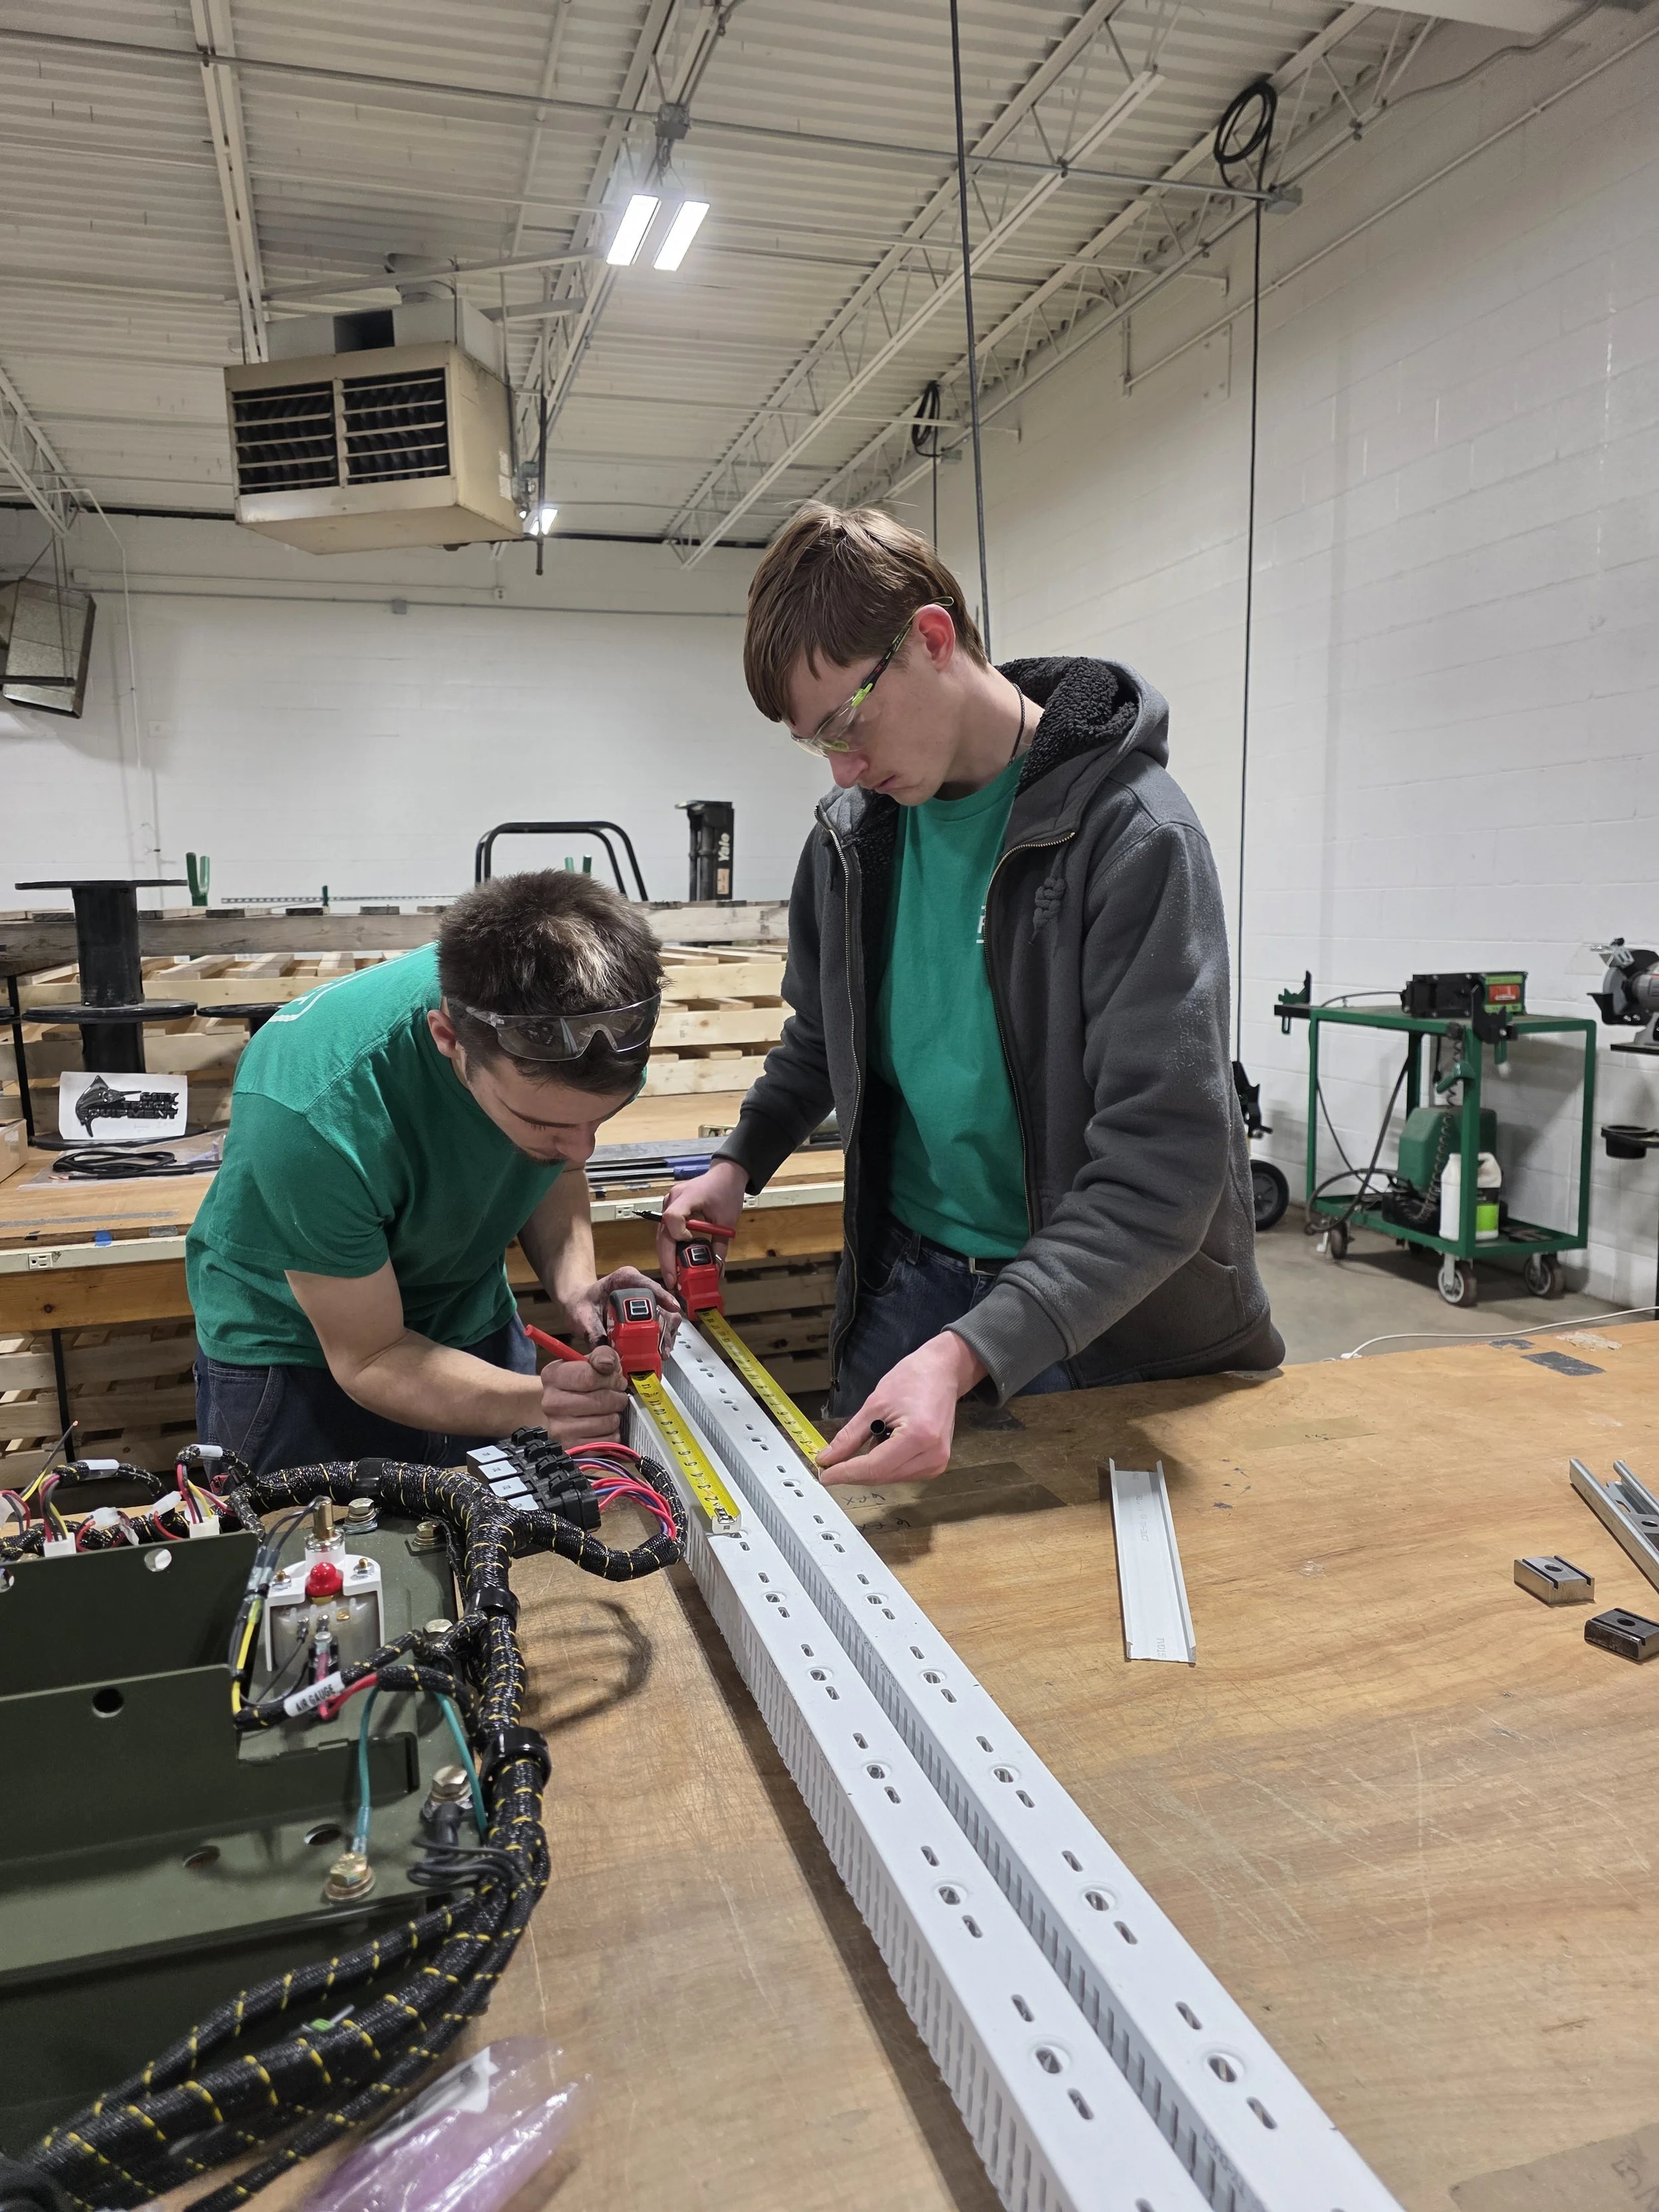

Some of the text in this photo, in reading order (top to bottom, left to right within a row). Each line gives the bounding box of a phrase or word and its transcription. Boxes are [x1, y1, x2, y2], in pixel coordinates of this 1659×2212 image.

[140, 1092, 179, 1101] CITY
[121, 1101, 179, 1110] TRUCK
[79, 1108, 179, 1119] EQUIPMENT
[295, 1684, 336, 1712] AIR GAUGE
